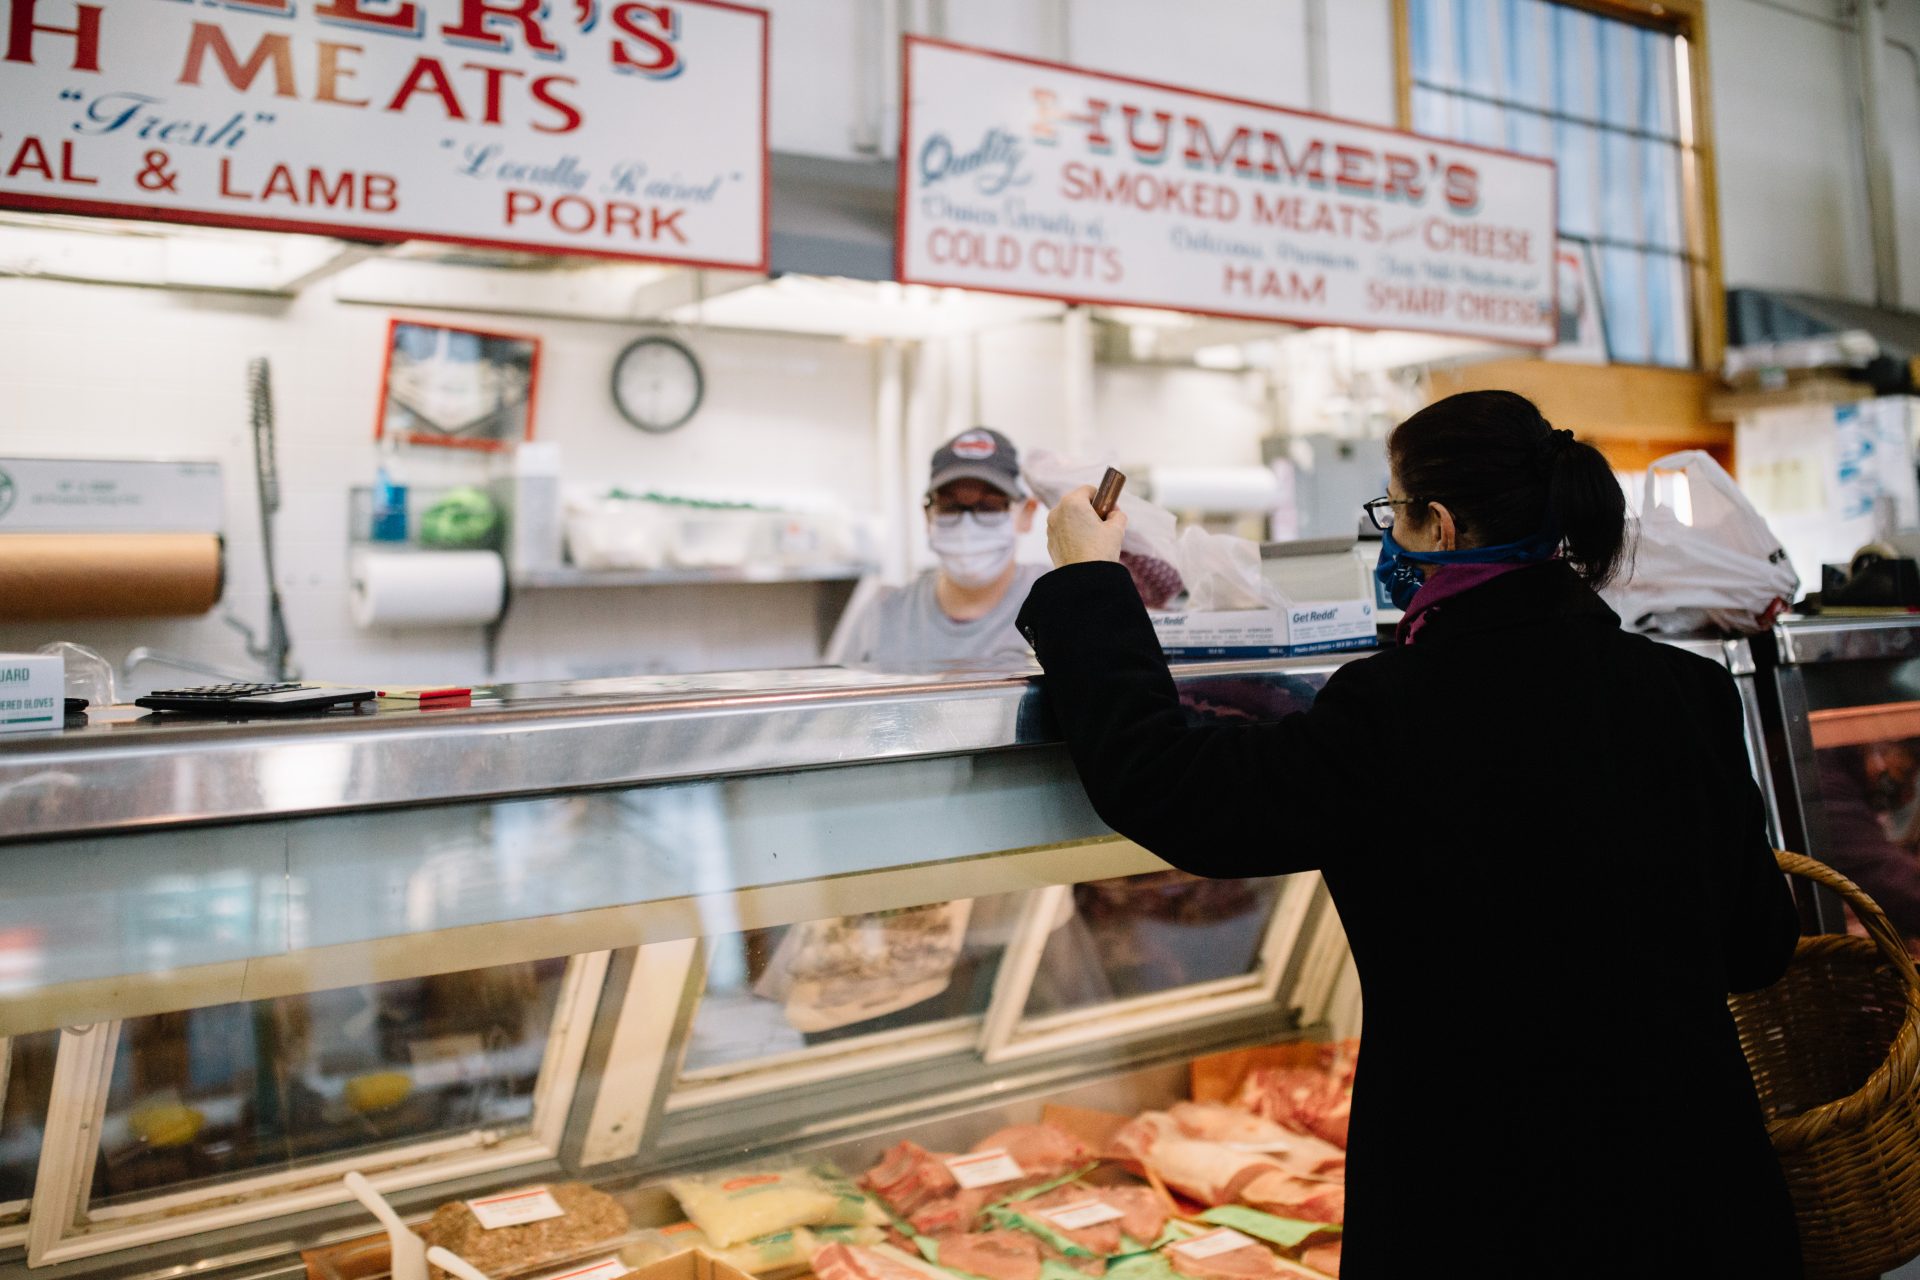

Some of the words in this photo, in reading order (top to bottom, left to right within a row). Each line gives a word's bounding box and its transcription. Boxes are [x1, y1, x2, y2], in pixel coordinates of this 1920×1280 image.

[177, 20, 583, 134] MEATS
[0, 135, 98, 185] AL
[136, 149, 178, 193] &
[219, 157, 400, 214] LAMB
[920, 128, 1032, 196] Quality
[1031, 87, 1482, 217] HUMMER'S
[504, 190, 688, 243] PORK
[1062, 161, 1239, 222] SMOKED
[1252, 190, 1383, 243] MEATS
[1422, 214, 1536, 265] CHEESE
[927, 226, 1021, 272] COLD
[1028, 239, 1125, 284] CUTS
[1223, 262, 1327, 304] HAM
[1367, 278, 1447, 316] SHARP
[1293, 613, 1309, 623] Get
[24, 697, 54, 709] GLOVES
